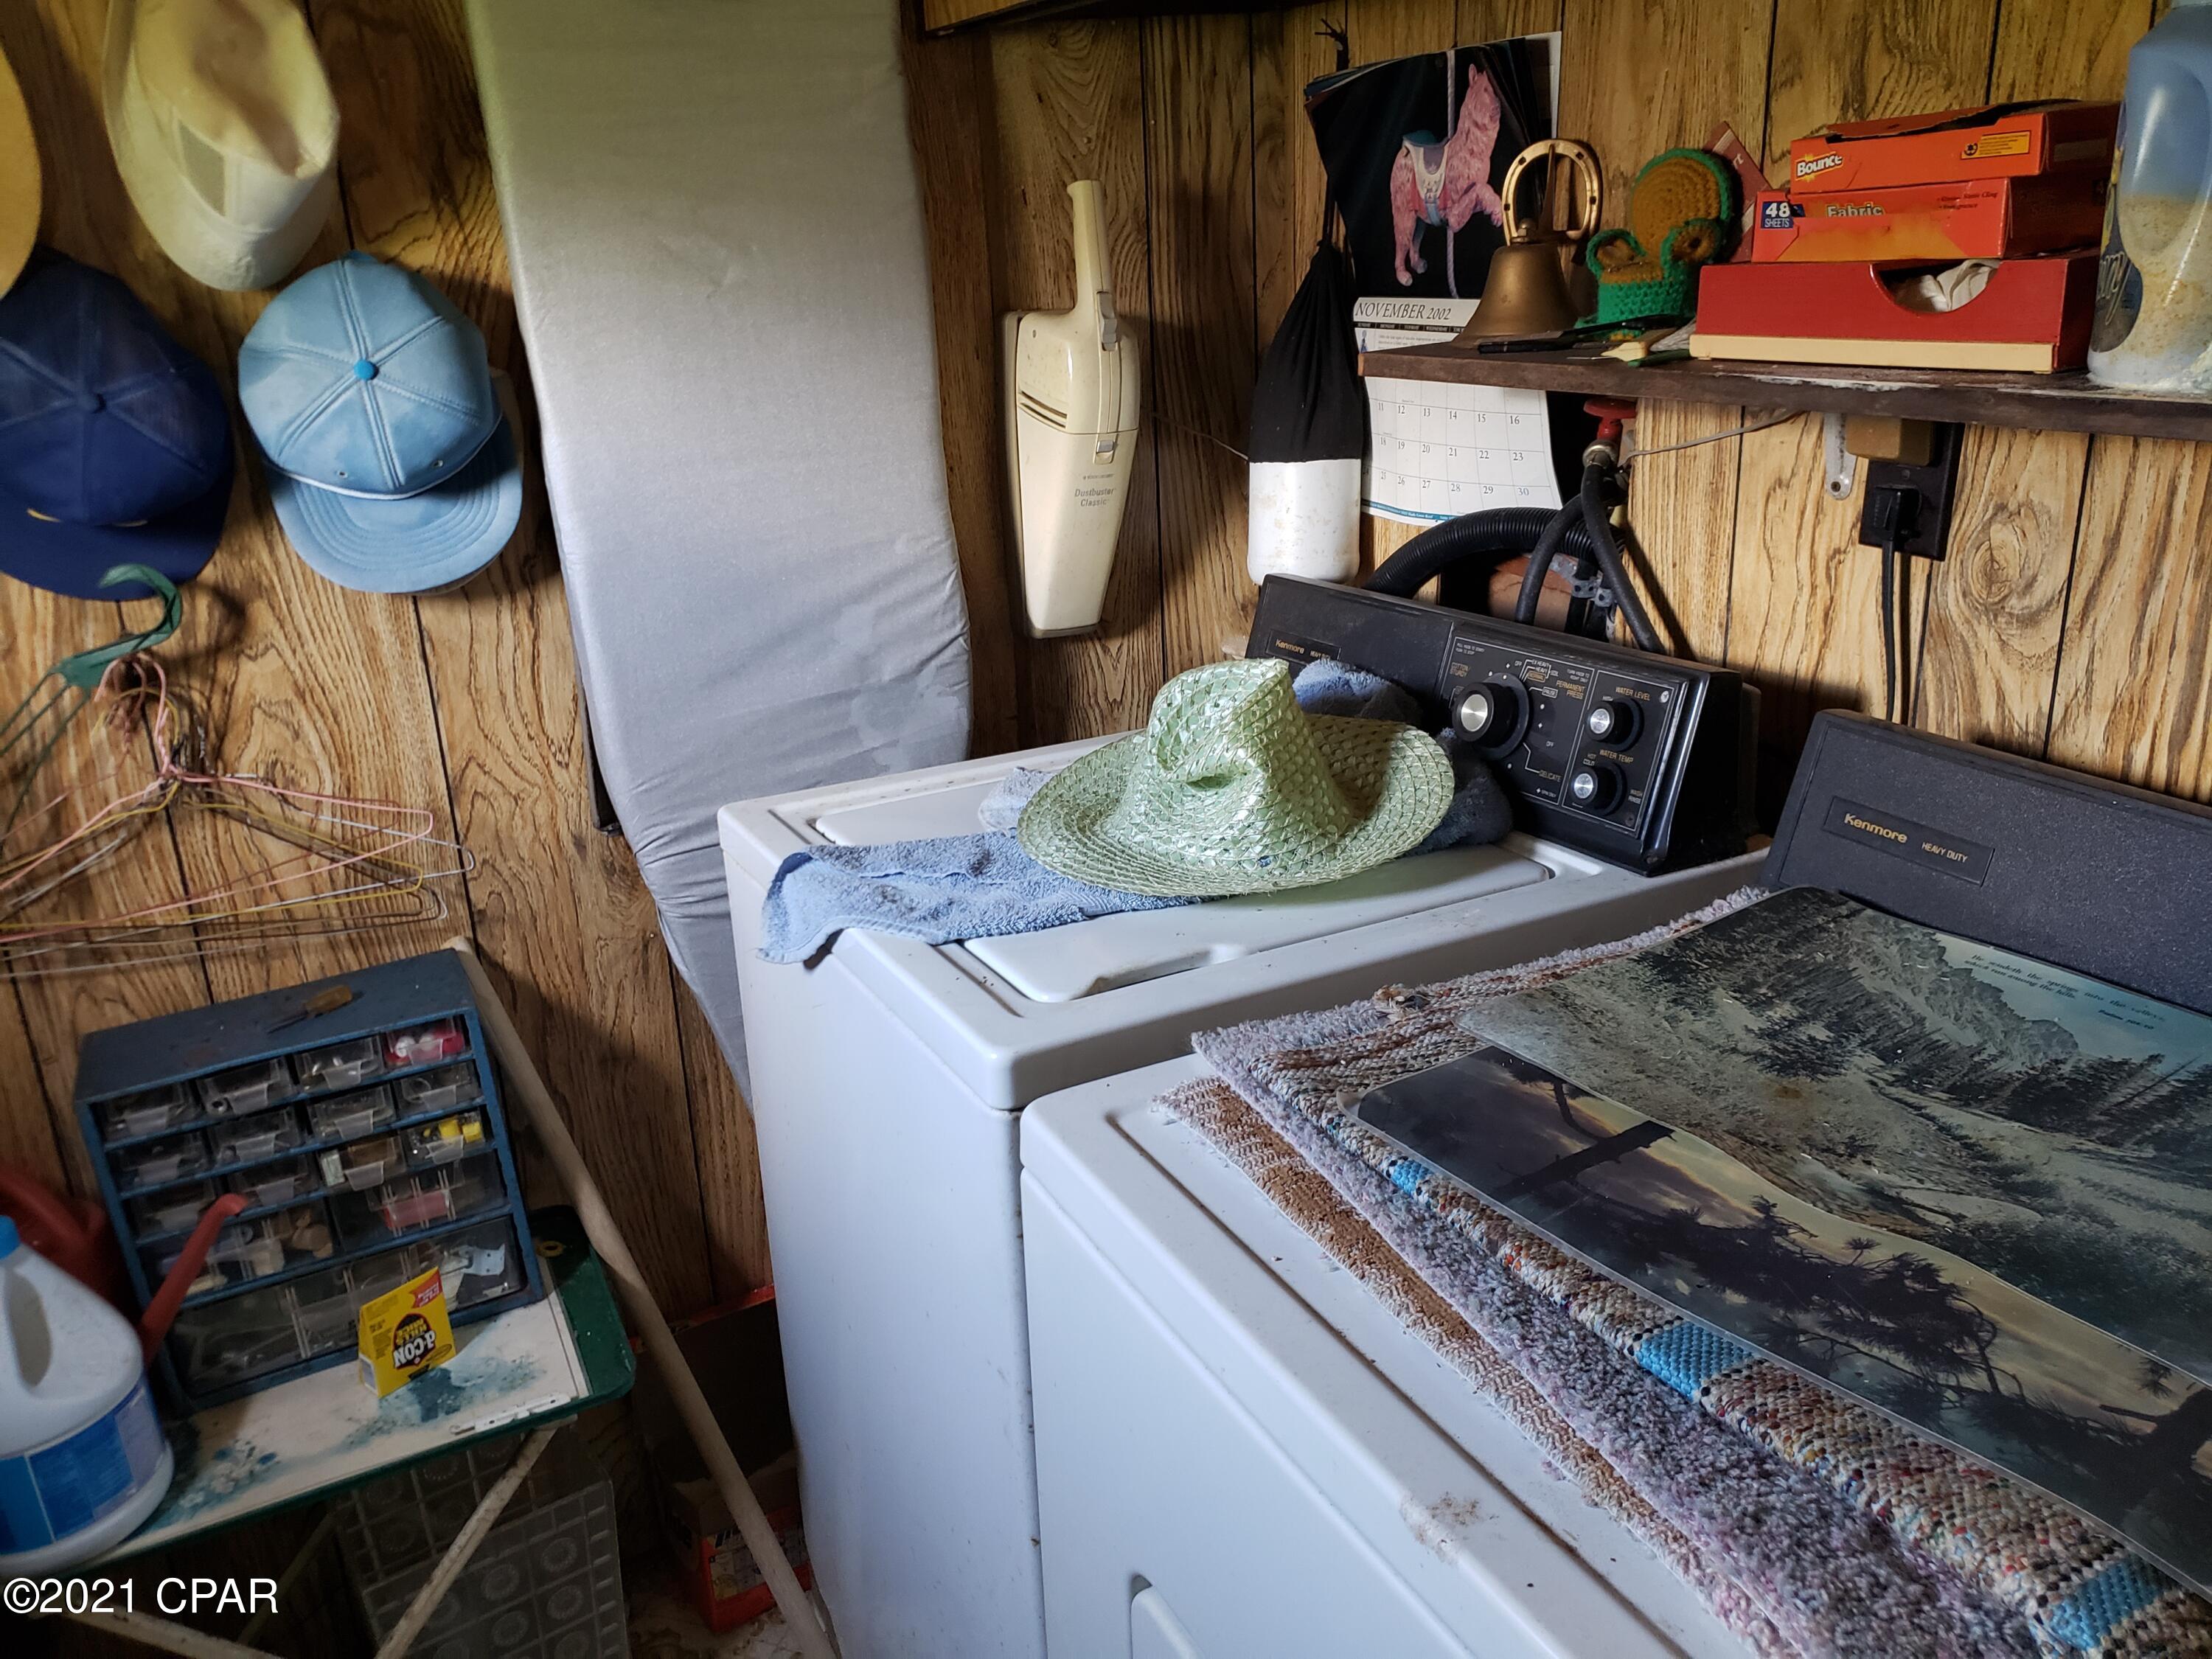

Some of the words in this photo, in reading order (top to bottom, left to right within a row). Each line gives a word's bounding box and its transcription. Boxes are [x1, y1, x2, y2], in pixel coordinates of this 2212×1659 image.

[1797, 154, 1843, 176] Bounce
[1765, 202, 1791, 218] 48
[1827, 201, 1883, 217] Fabric
[1764, 218, 1790, 227] SHEETS
[1355, 302, 1426, 319] NOVEMBER
[1427, 307, 1452, 320] 2002
[1398, 406, 1405, 414] 12
[1424, 408, 1430, 417] 13
[1449, 411, 1457, 420] 14
[1478, 414, 1486, 422] 15
[1510, 415, 1520, 424] 16
[1398, 441, 1405, 450] 19
[1422, 444, 1430, 453] 20
[1449, 447, 1457, 456] 21
[1479, 450, 1489, 459] 22
[1513, 452, 1523, 461] 23
[1074, 488, 1114, 497] Dustbuster
[1398, 476, 1405, 485] 26
[1422, 480, 1431, 489] 27
[1451, 483, 1461, 493] 28
[1484, 486, 1494, 495] 29
[1518, 487, 1529, 496] 30
[1080, 498, 1107, 507] Classic
[1276, 639, 1304, 654] Kenmore
[1556, 680, 1585, 692] PERMANENT
[1615, 686, 1633, 697] WATER
[1635, 690, 1650, 700] LEVEL
[1599, 749, 1618, 759] WATER
[1618, 754, 1634, 764] TEMP
[1844, 813, 1908, 844] Kenmore
[1921, 842, 1946, 856] HEAVY
[1947, 849, 1968, 863] DUTY
